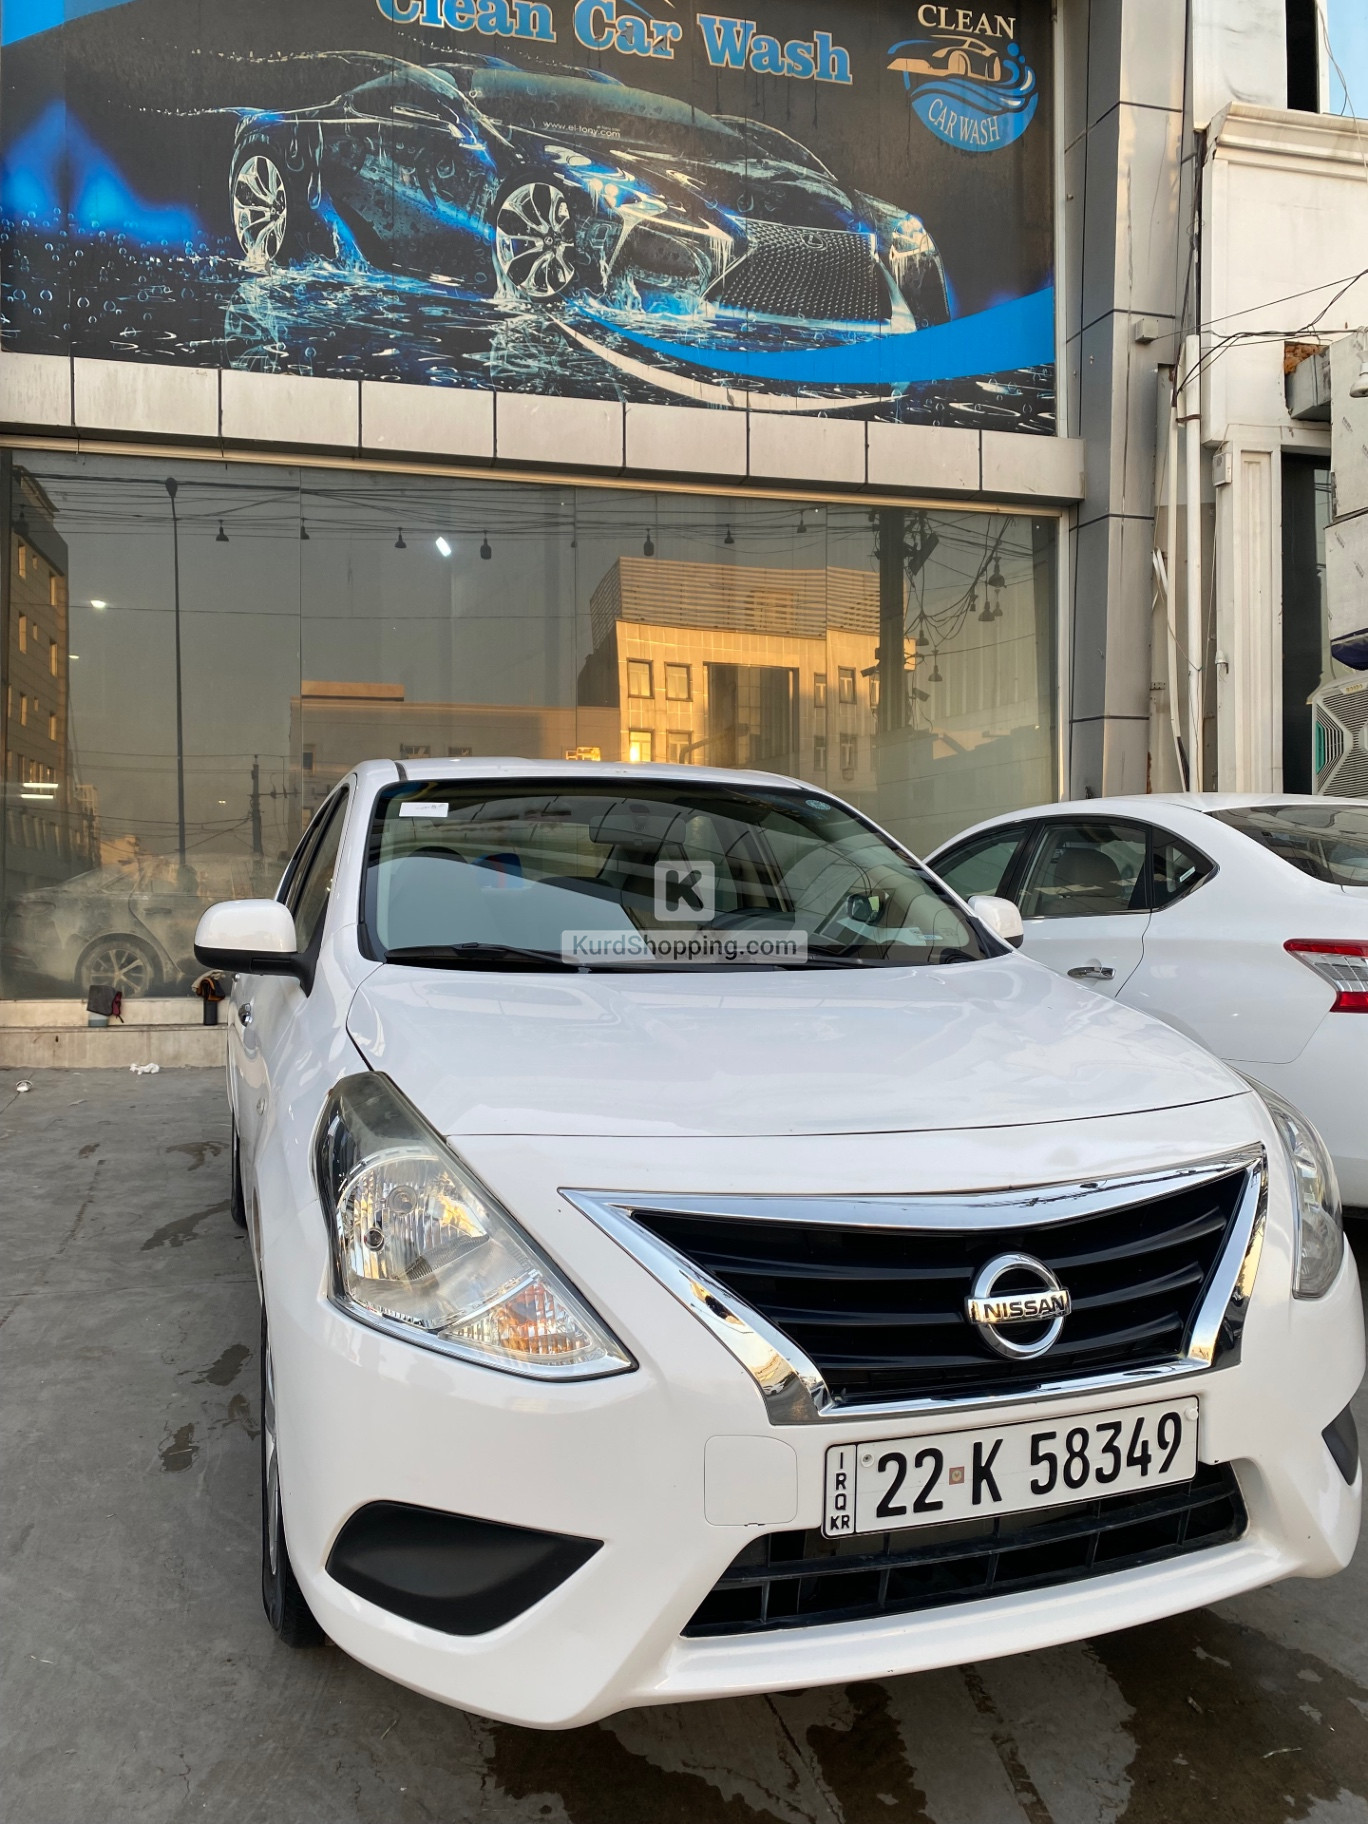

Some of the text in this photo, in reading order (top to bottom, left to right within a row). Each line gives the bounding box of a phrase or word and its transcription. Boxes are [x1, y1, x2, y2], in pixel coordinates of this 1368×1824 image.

[917, 4, 1016, 39] CLEAN
[573, 0, 683, 60] Car
[697, 13, 853, 85] Wash
[928, 98, 1001, 145] CAR WASH
[983, 1294, 1065, 1319] NISSAN
[876, 1411, 1183, 1518] 22 K 58349
[830, 1514, 850, 1530] KR
